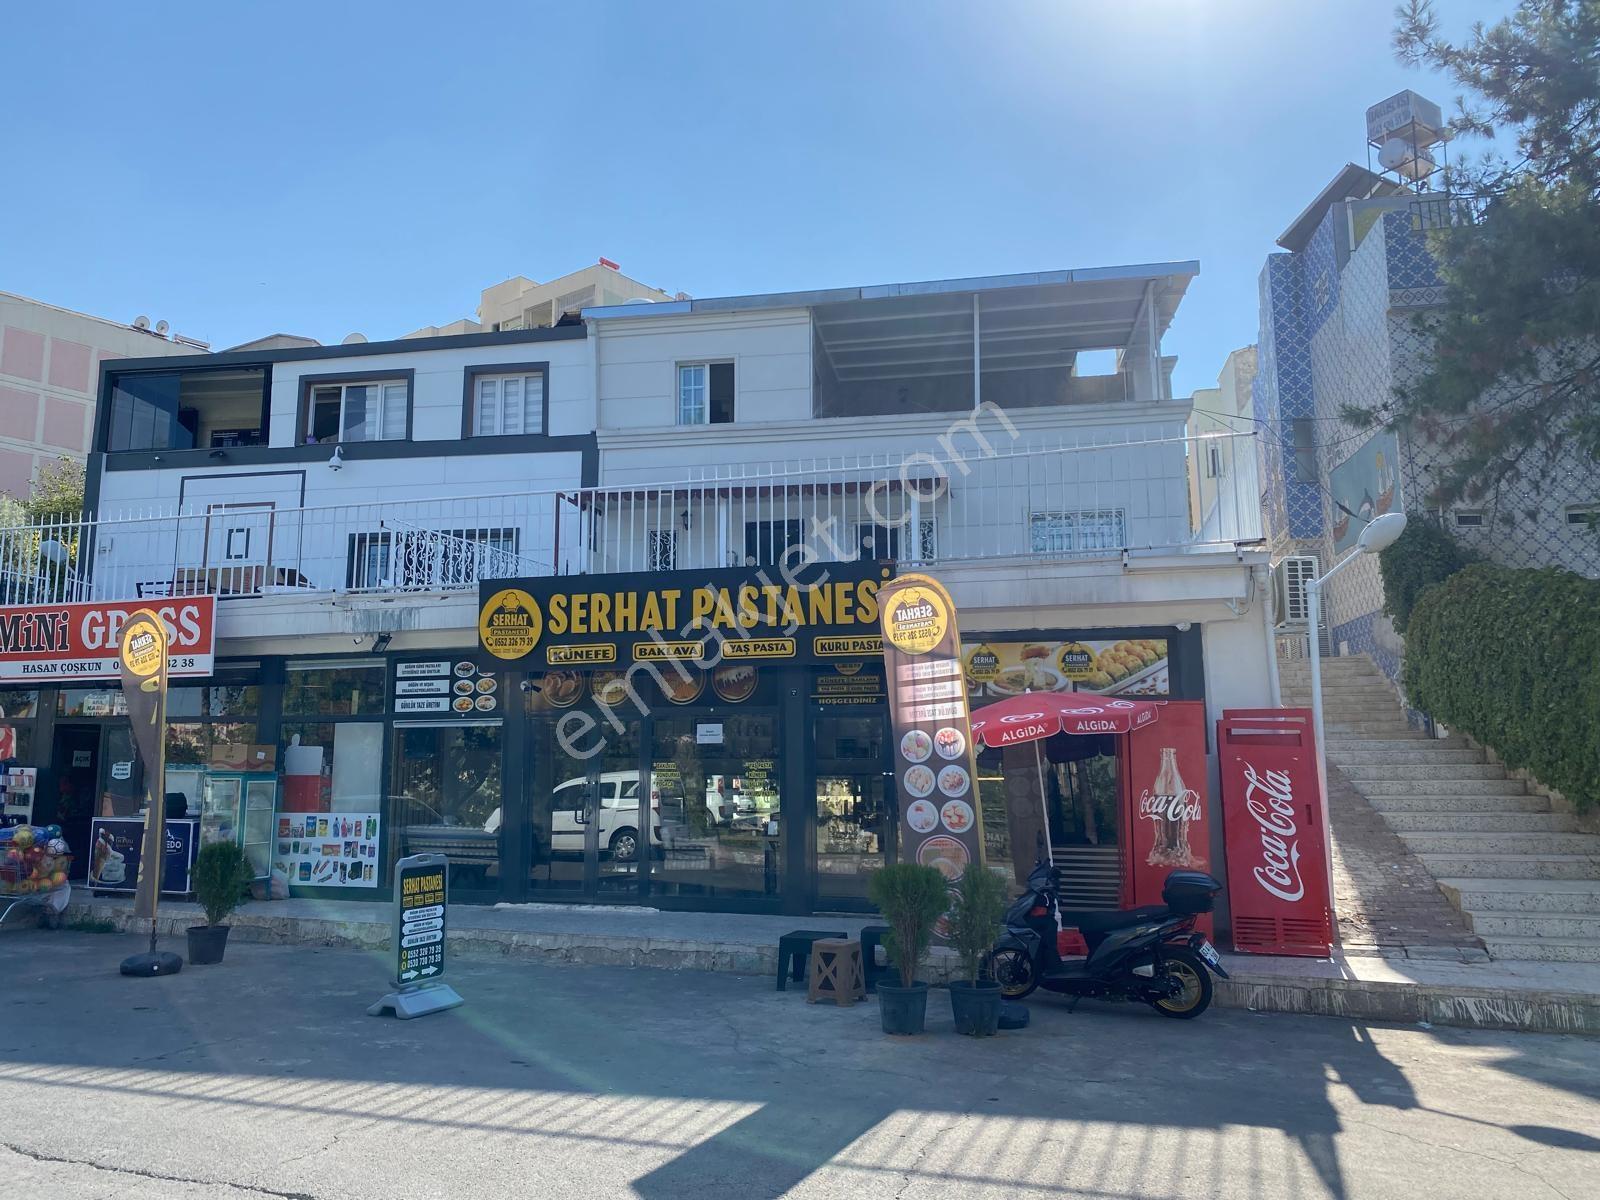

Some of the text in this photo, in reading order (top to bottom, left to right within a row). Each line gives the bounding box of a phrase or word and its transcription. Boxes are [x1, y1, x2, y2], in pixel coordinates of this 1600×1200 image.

[549, 590, 681, 635] SERHAT
[493, 614, 529, 626] SERHAT
[81, 606, 201, 650] GRSS
[638, 644, 698, 657] BAKLAVA
[730, 642, 787, 656] YAŞ PASTA
[820, 640, 883, 652] KURU PASTA
[552, 647, 611, 661] KÜNEFE
[973, 656, 996, 664] SERHAT
[1065, 654, 1089, 662] SERHAT
[22, 663, 57, 674] HASAN
[61, 662, 102, 675] ÇOŞKUN
[181, 658, 195, 668] 38
